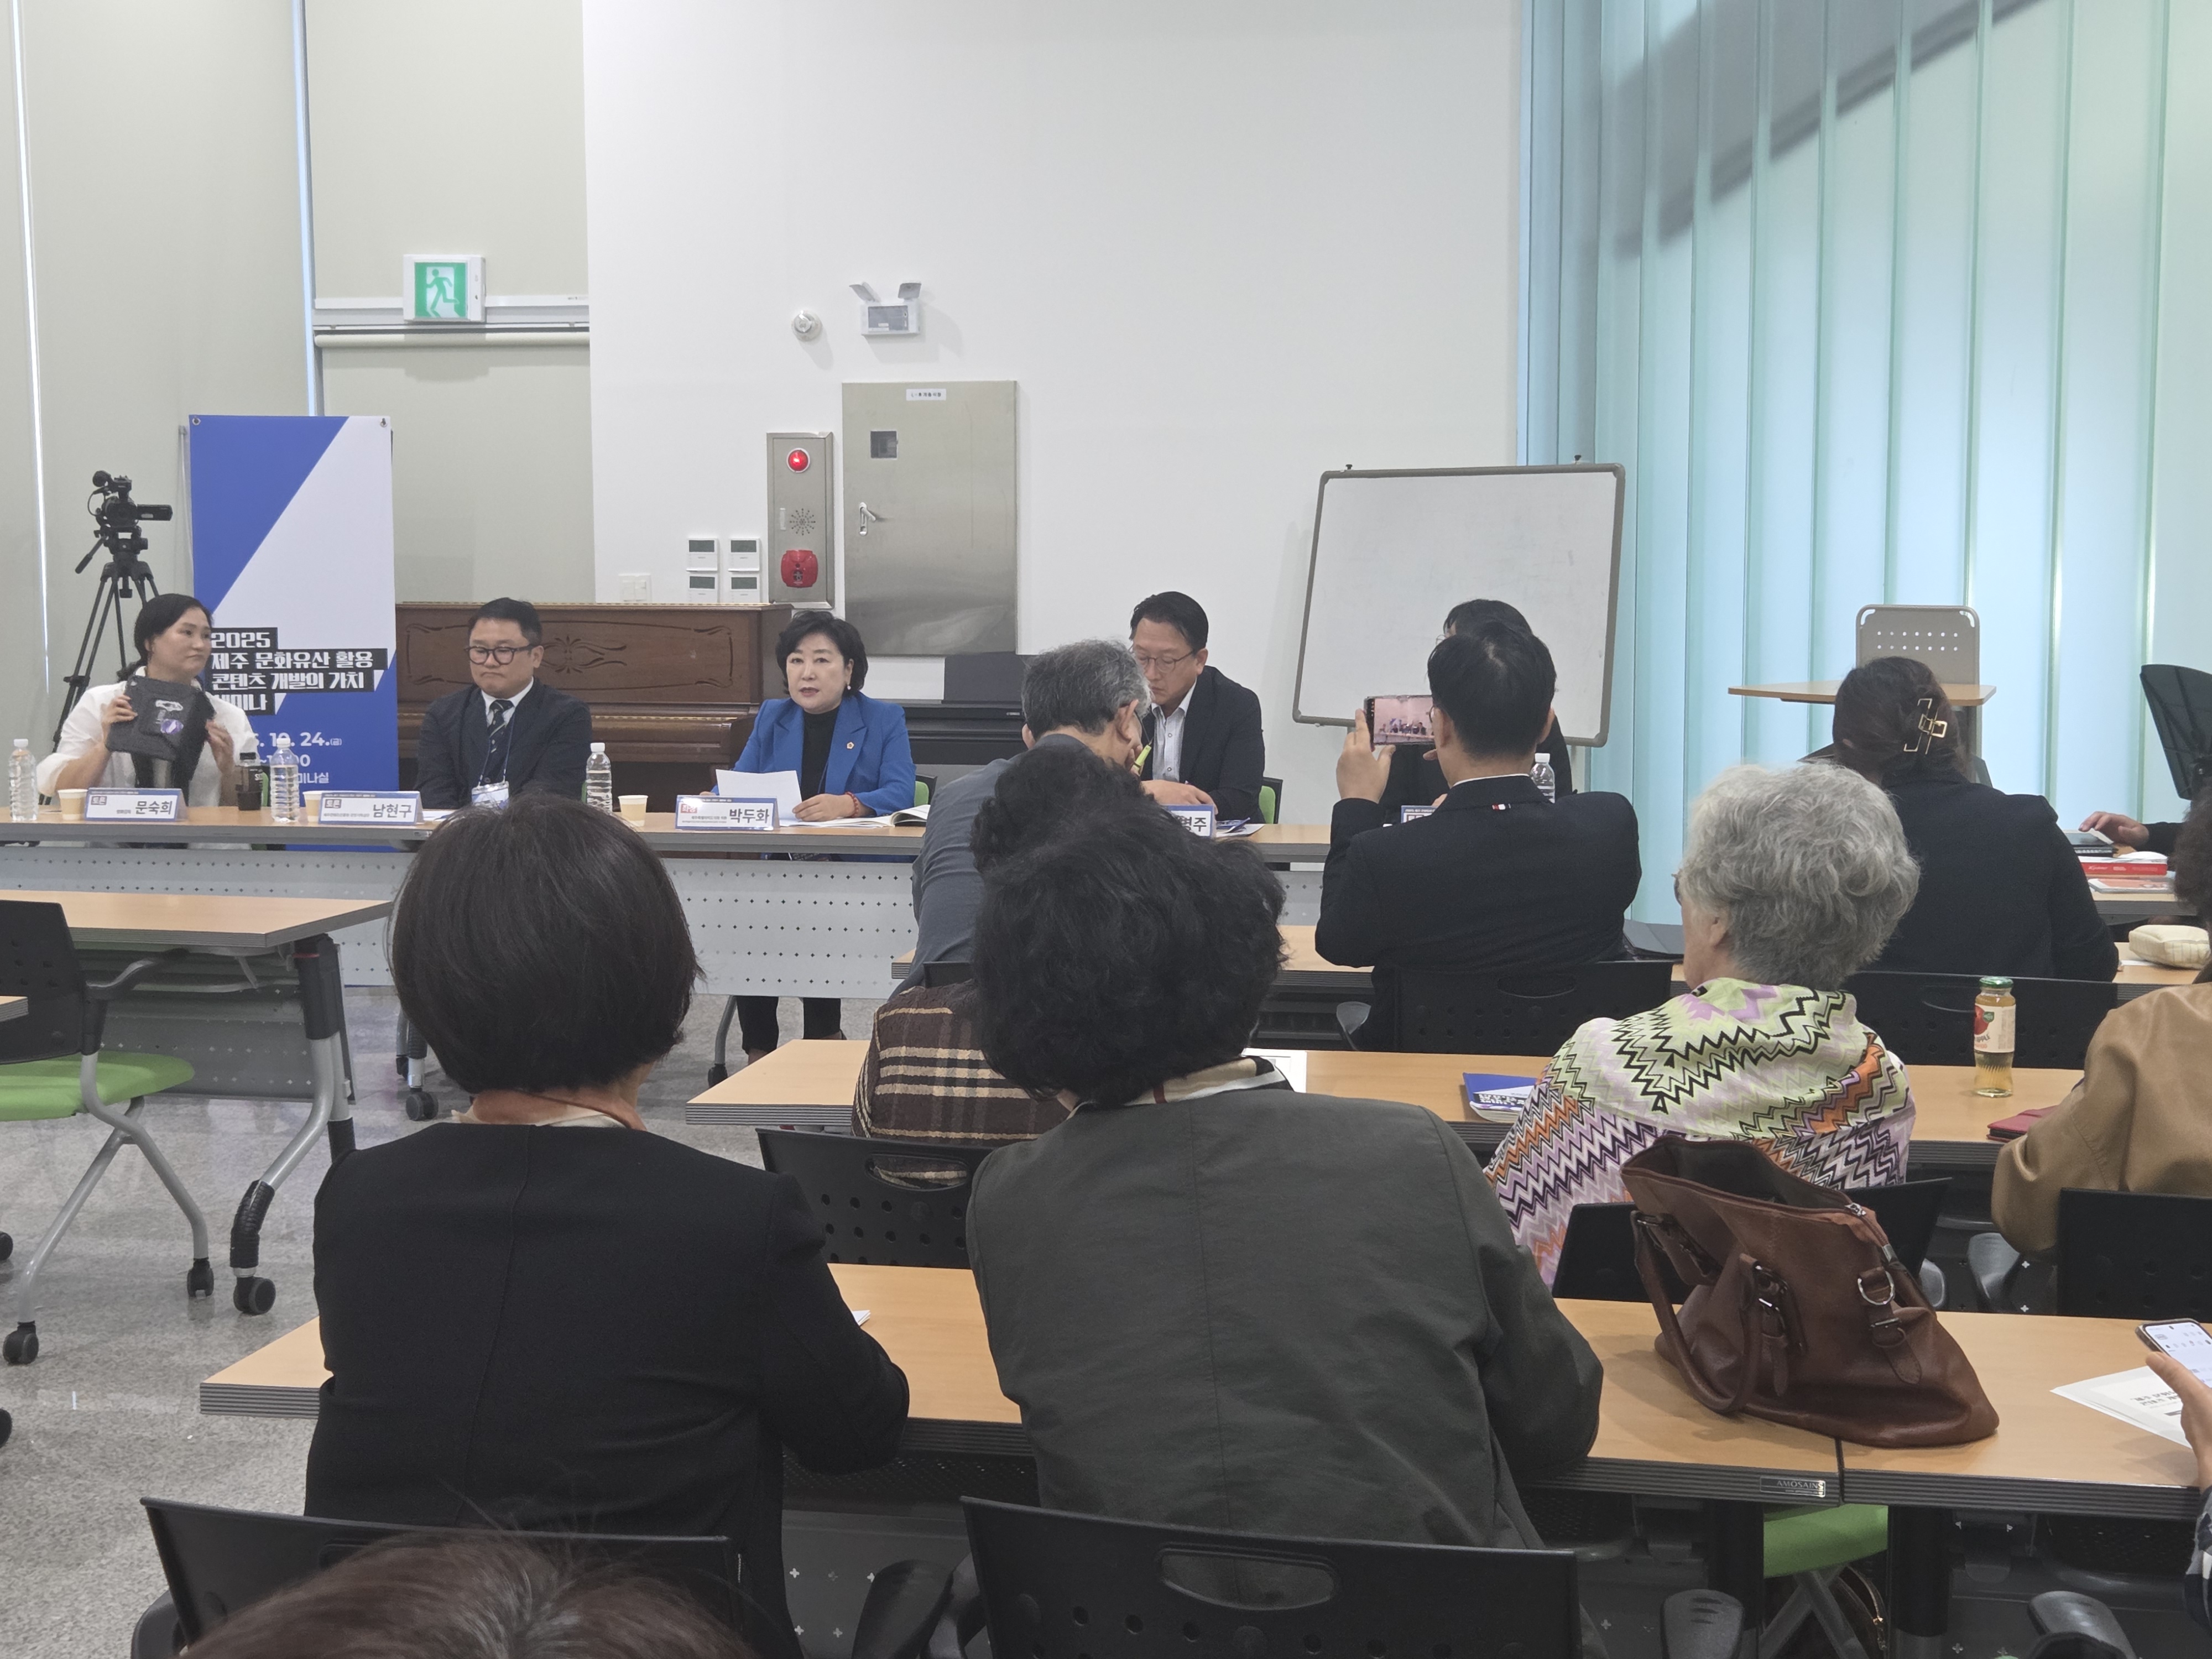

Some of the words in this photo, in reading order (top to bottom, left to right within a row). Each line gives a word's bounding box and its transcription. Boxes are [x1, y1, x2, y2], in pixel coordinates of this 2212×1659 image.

[211, 633, 270, 648] 2025
[211, 652, 249, 670] 제주
[254, 651, 331, 669] 문화유산
[336, 651, 373, 668] 활용
[212, 673, 267, 690] 콘텐츠
[270, 672, 324, 689] 개발의
[328, 671, 364, 688] 가치
[135, 801, 173, 815] 문숙희
[373, 804, 411, 818] 남현구
[729, 808, 769, 823] 박두화
[1777, 1480, 1823, 1489] AMOSAINS
